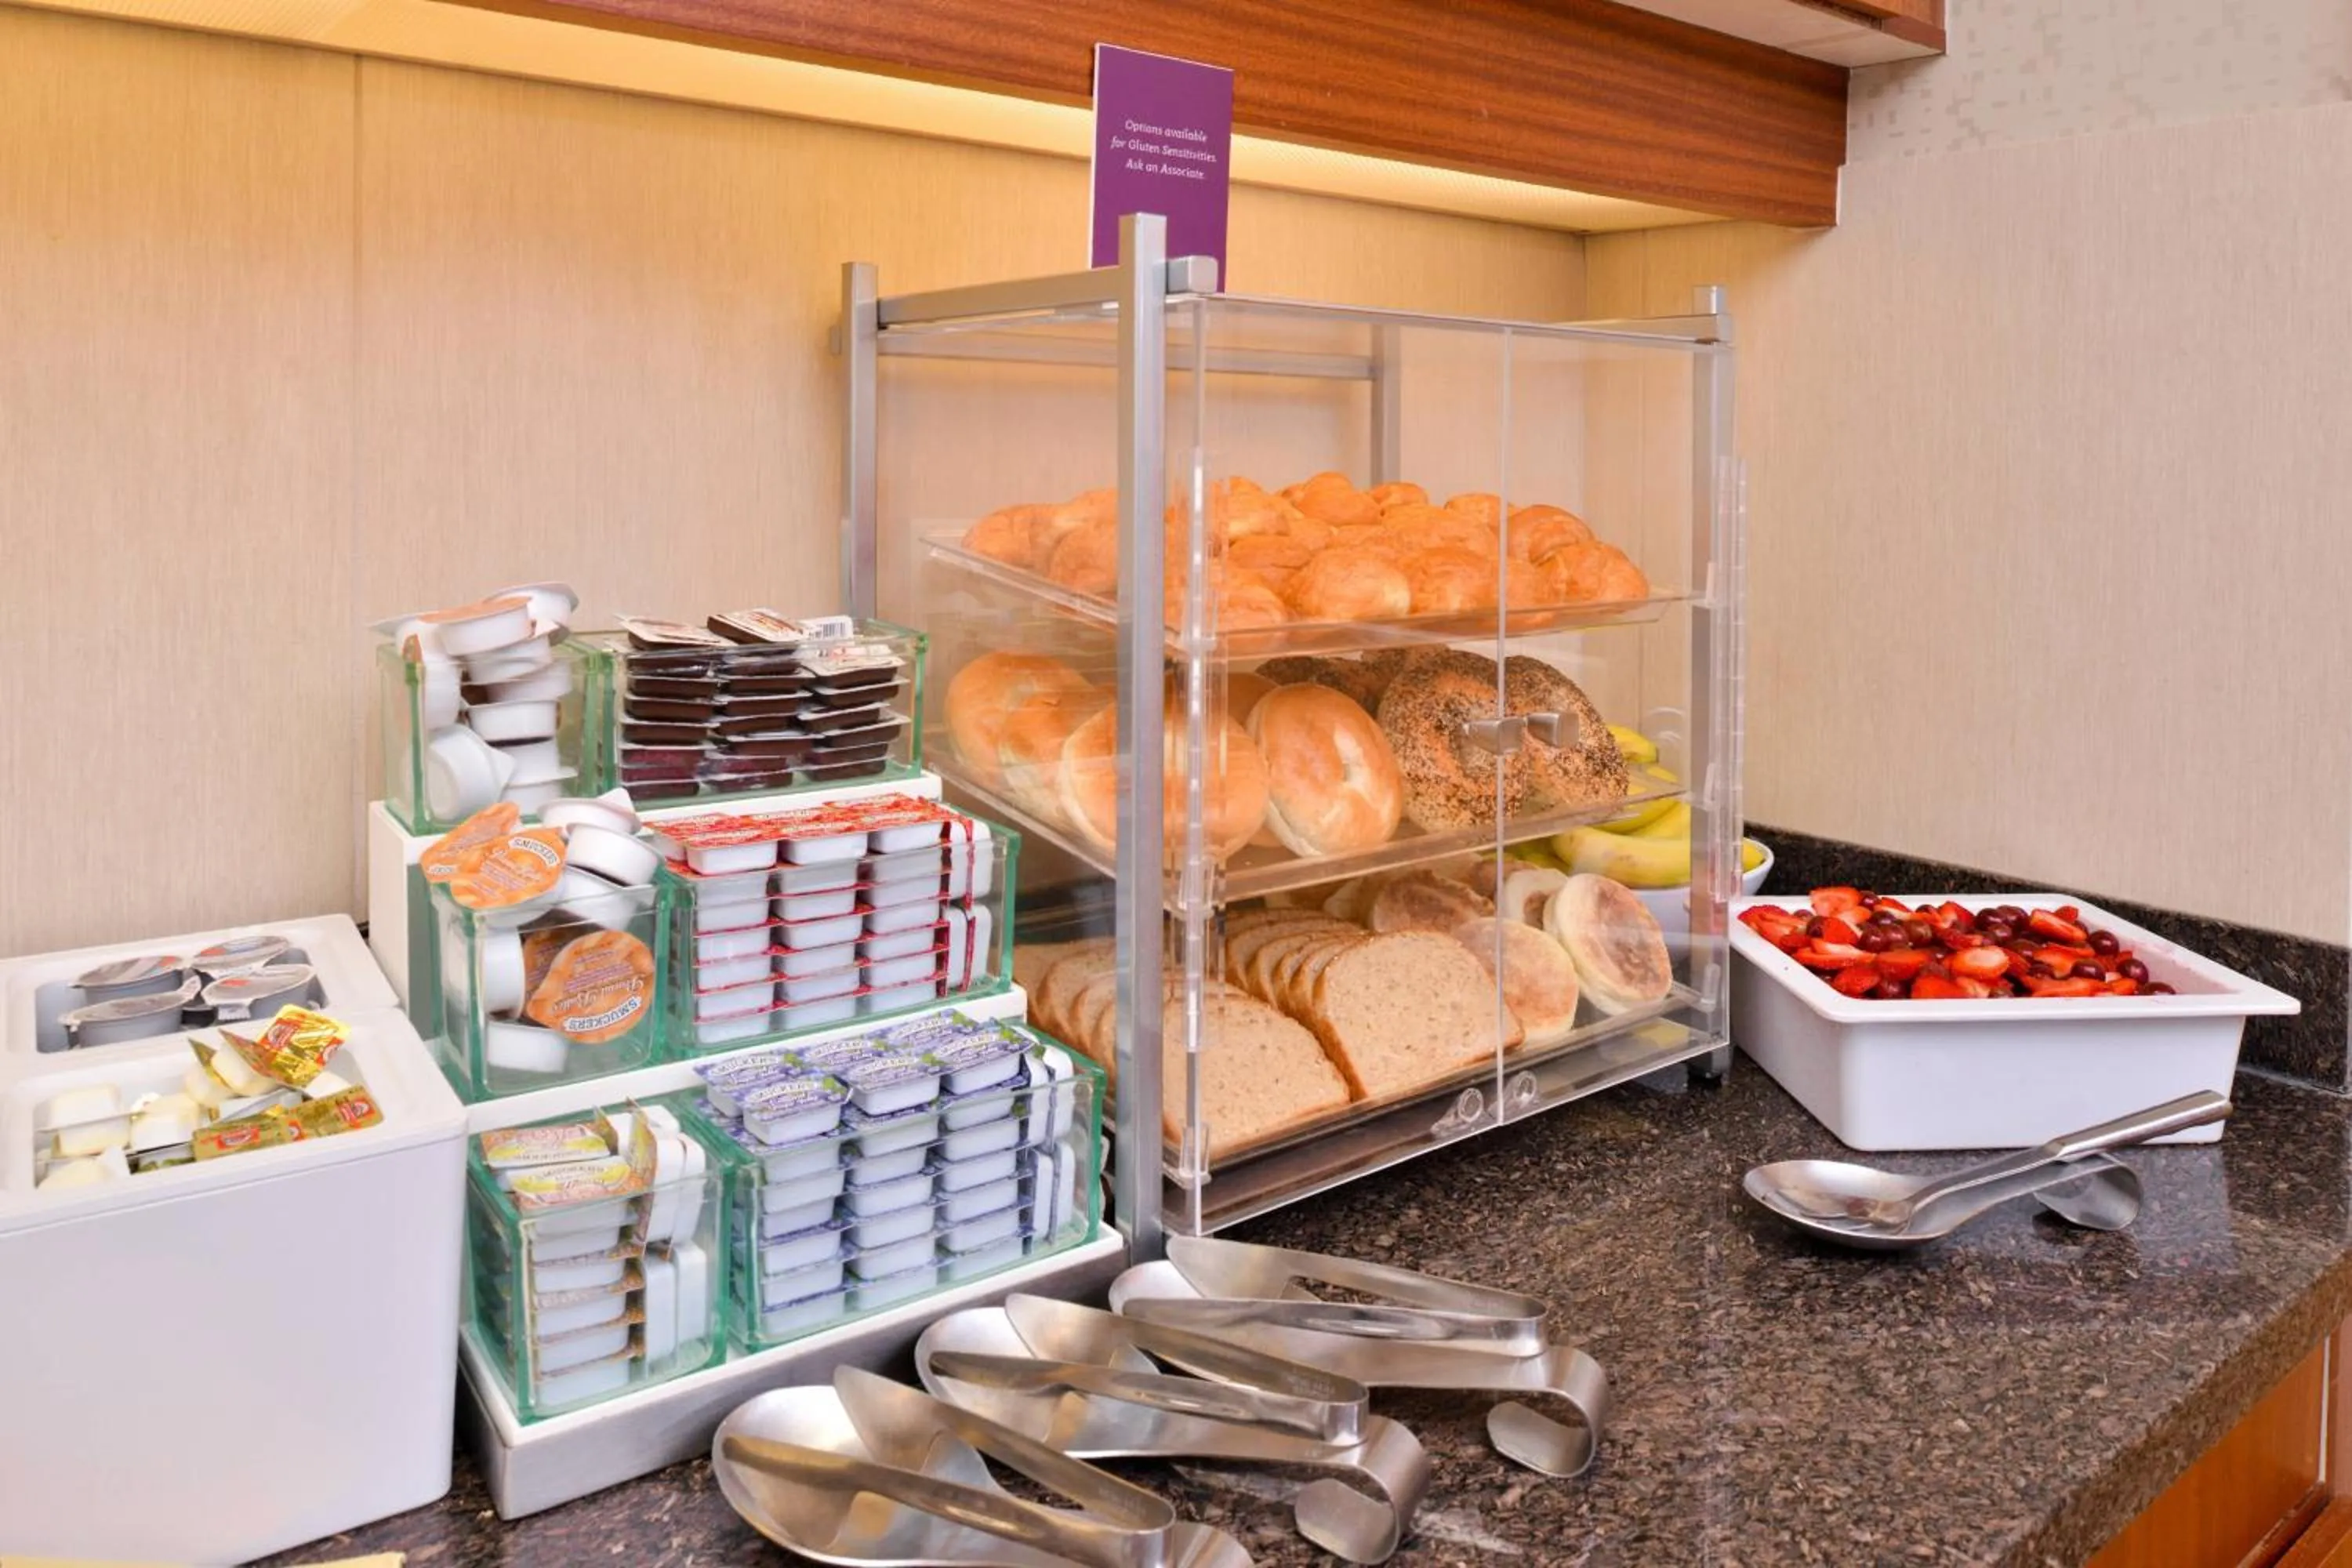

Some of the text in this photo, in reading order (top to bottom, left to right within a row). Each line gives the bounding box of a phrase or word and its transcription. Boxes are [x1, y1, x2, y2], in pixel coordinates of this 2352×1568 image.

[1125, 119, 1207, 142] Options available
[1110, 136, 1127, 149] for
[1128, 139, 1160, 154] Gluten
[1125, 158, 1144, 171] Ask
[1145, 163, 1158, 172] an
